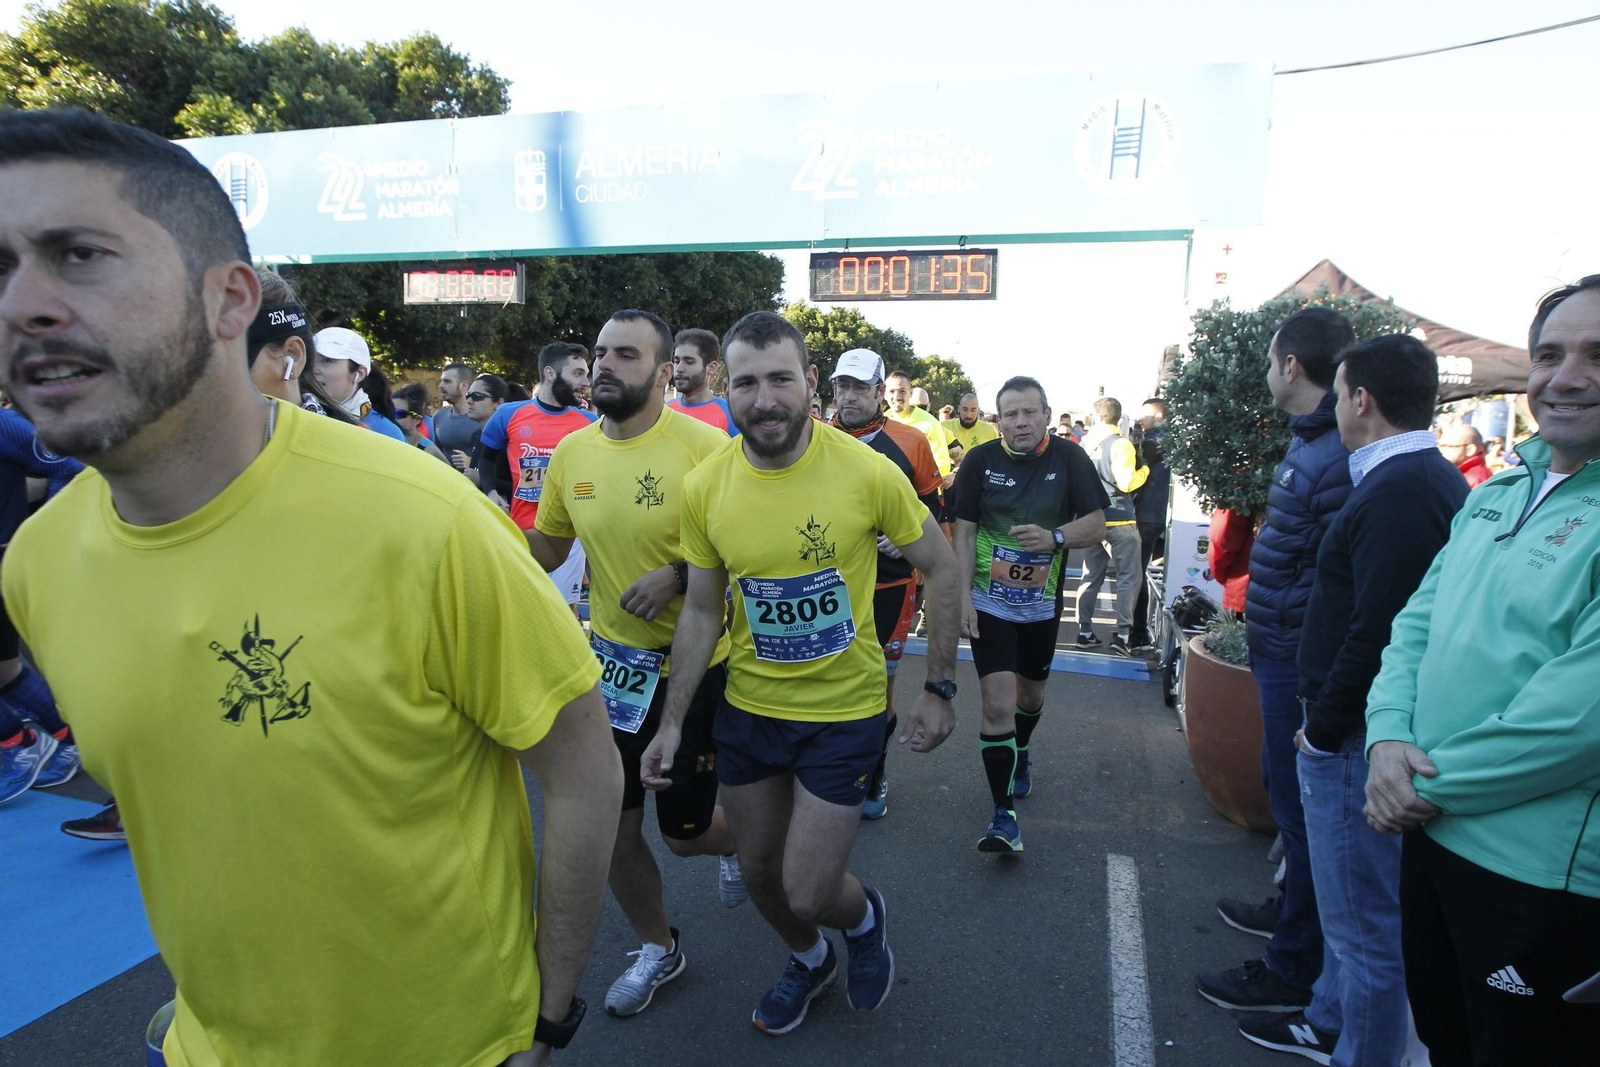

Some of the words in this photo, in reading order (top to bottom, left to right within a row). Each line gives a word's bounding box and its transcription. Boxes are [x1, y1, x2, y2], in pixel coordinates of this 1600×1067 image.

[874, 127, 952, 148] MEDIO
[575, 135, 723, 178] ALMERÍA
[874, 145, 994, 173] MARATÓN
[378, 159, 429, 178] MEDIO
[375, 174, 460, 199] MARATÓN
[575, 181, 649, 203] CIUDAD
[874, 170, 980, 197] ALMERÍA
[377, 195, 452, 219] ALMERÍA
[268, 310, 287, 326] 25X
[525, 468, 547, 482] 21
[1009, 564, 1034, 582] 62
[1527, 559, 1544, 569] 2018
[803, 577, 838, 592] MARATÓN
[755, 591, 839, 625] 2806
[784, 622, 815, 632] JAVIER
[600, 682, 619, 696] OSCAR
[1487, 977, 1535, 996] adidas
